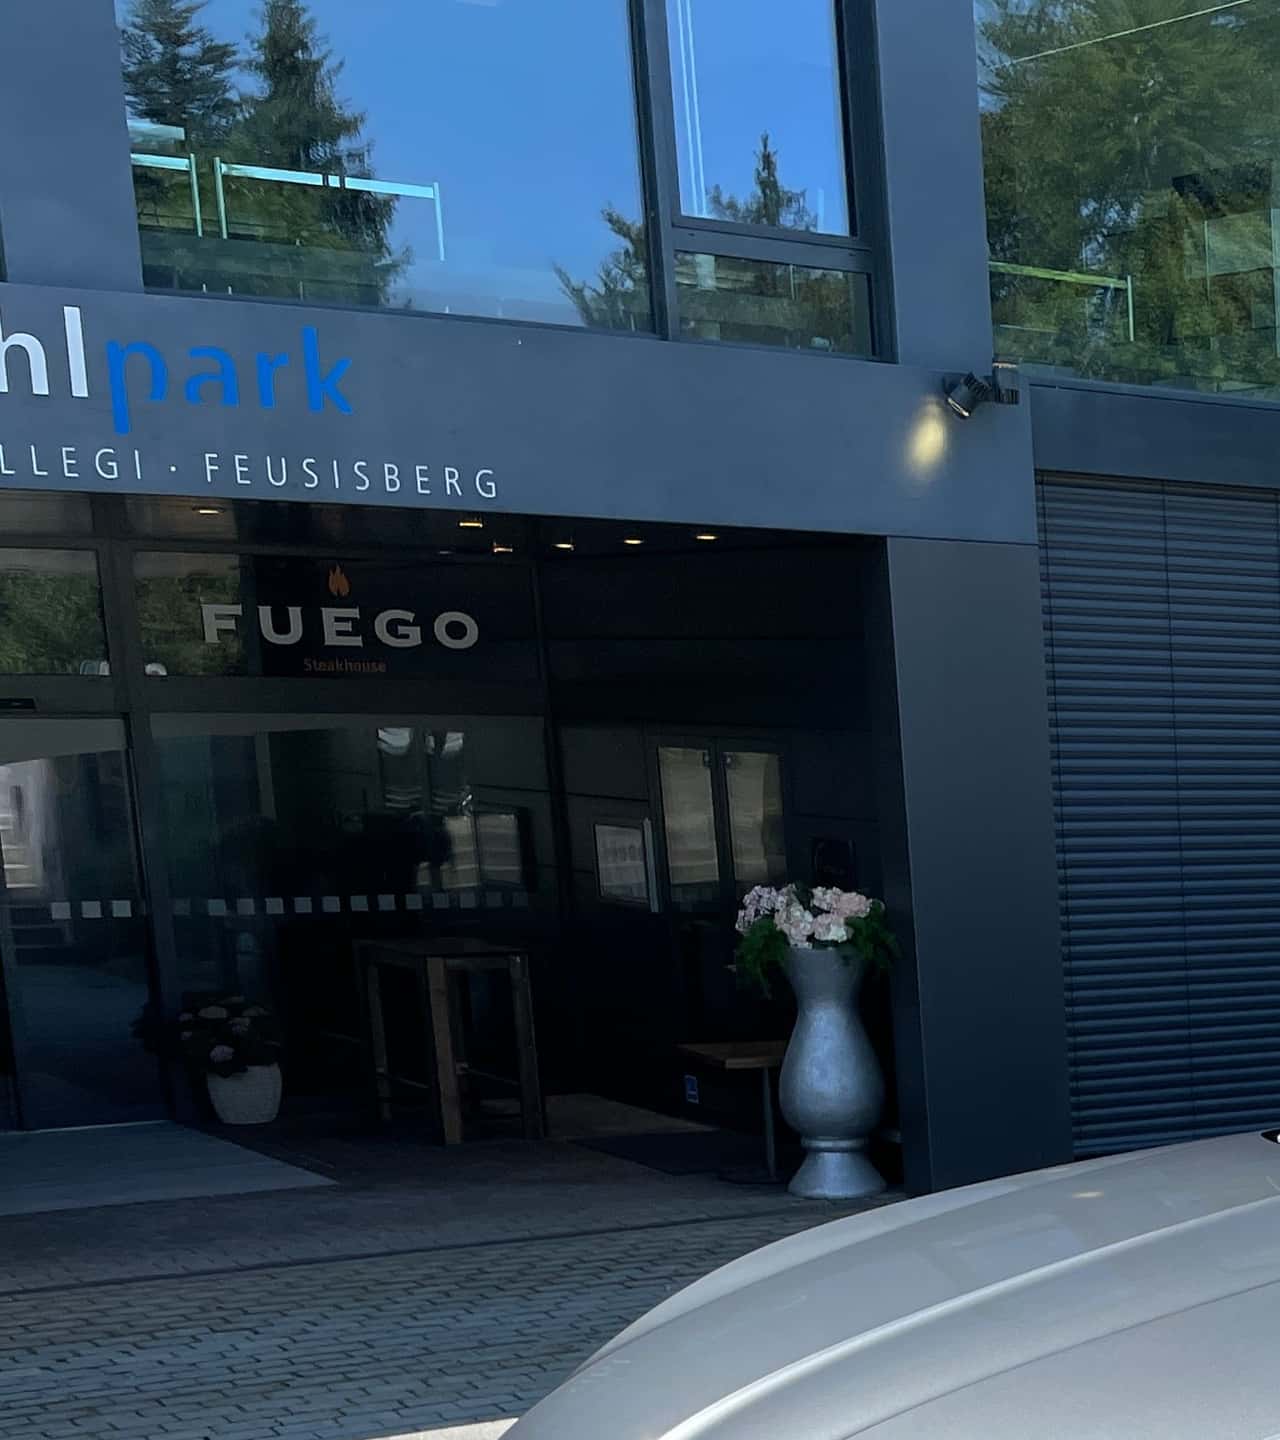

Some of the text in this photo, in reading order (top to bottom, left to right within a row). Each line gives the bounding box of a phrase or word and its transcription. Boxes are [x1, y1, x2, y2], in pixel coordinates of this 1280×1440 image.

[204, 453, 498, 499] FEUSISBERG
[201, 603, 479, 650] FUEGO
[303, 657, 386, 673] Steakhouse
